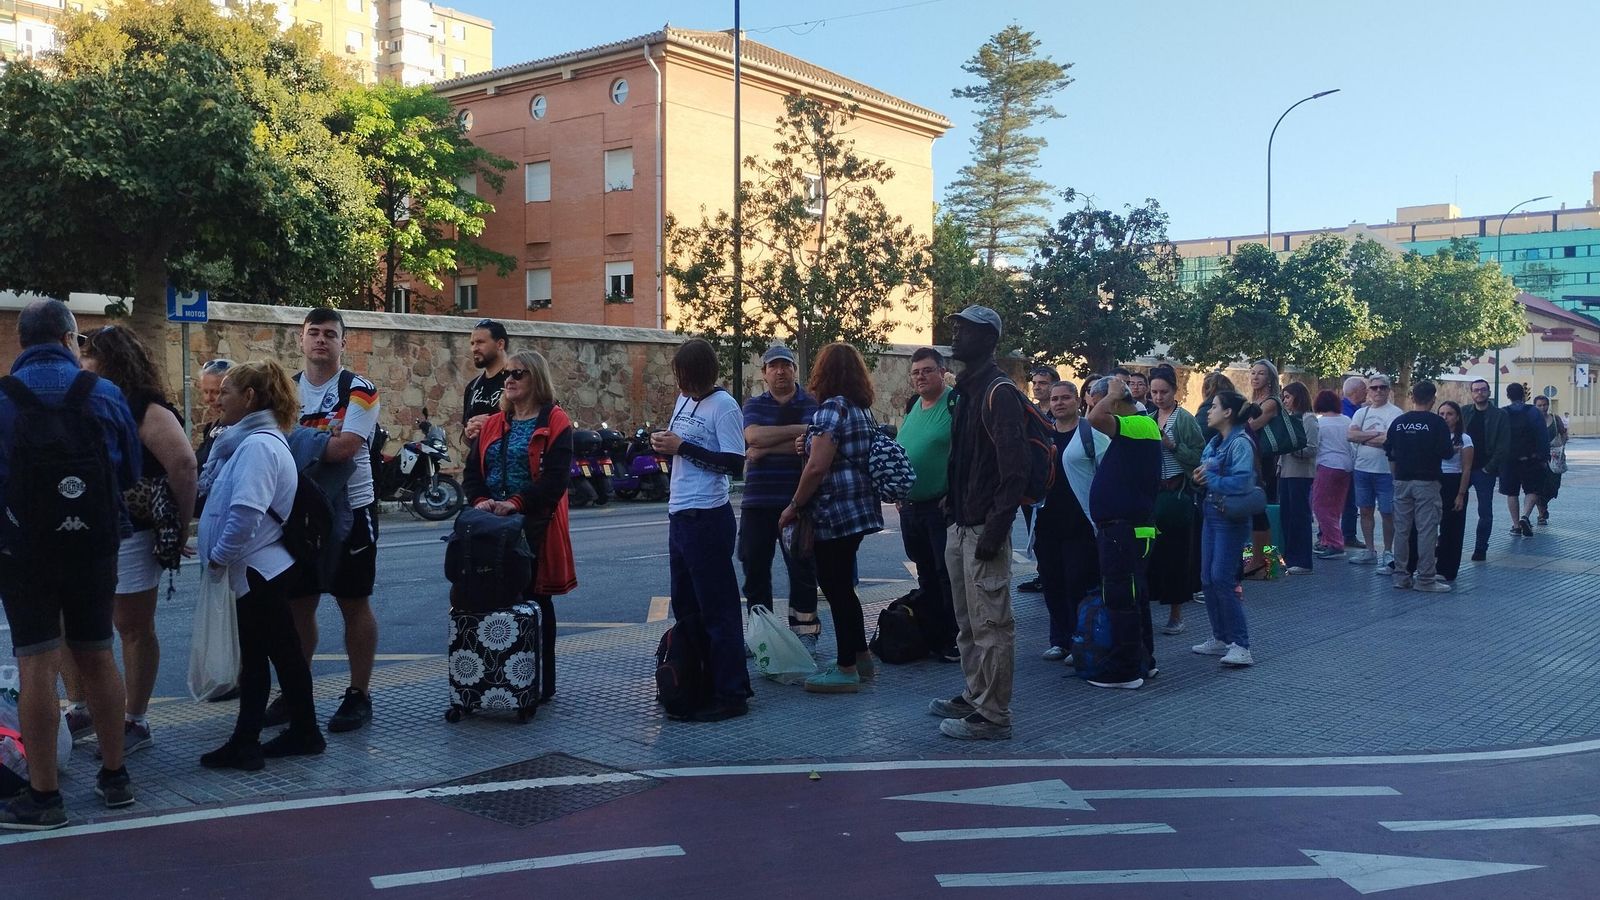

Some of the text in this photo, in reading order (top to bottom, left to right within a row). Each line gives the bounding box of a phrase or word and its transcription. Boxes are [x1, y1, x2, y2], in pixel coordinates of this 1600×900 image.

[175, 287, 199, 317] P
[185, 310, 206, 318] MOTOS
[1396, 422, 1430, 432] EVASA
